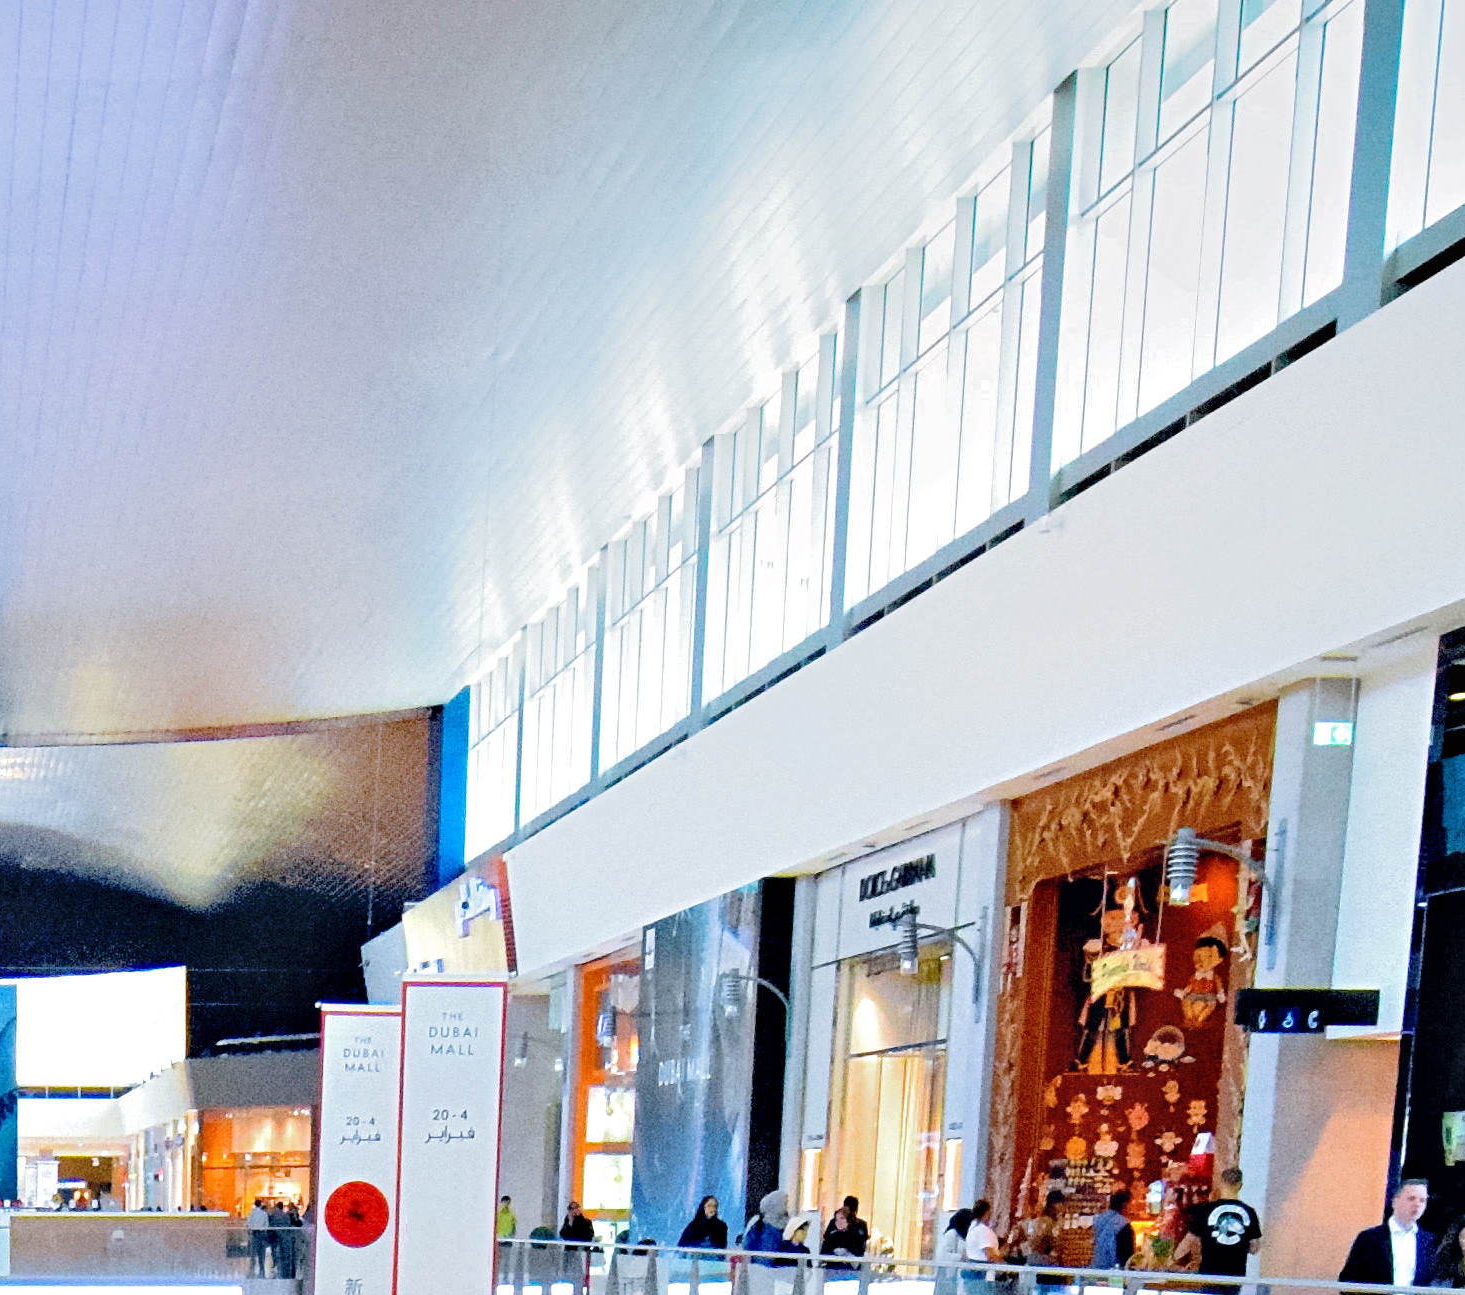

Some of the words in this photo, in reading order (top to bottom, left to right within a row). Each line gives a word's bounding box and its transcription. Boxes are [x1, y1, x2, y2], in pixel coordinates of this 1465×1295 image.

[442, 1012, 464, 1021] THE
[428, 1026, 479, 1038] DUBAI
[343, 1048, 384, 1059] DUBAI
[430, 1044, 474, 1056] MALL
[344, 1062, 381, 1073] MALL
[433, 1109, 450, 1121] 20
[346, 1116, 360, 1127] 20
